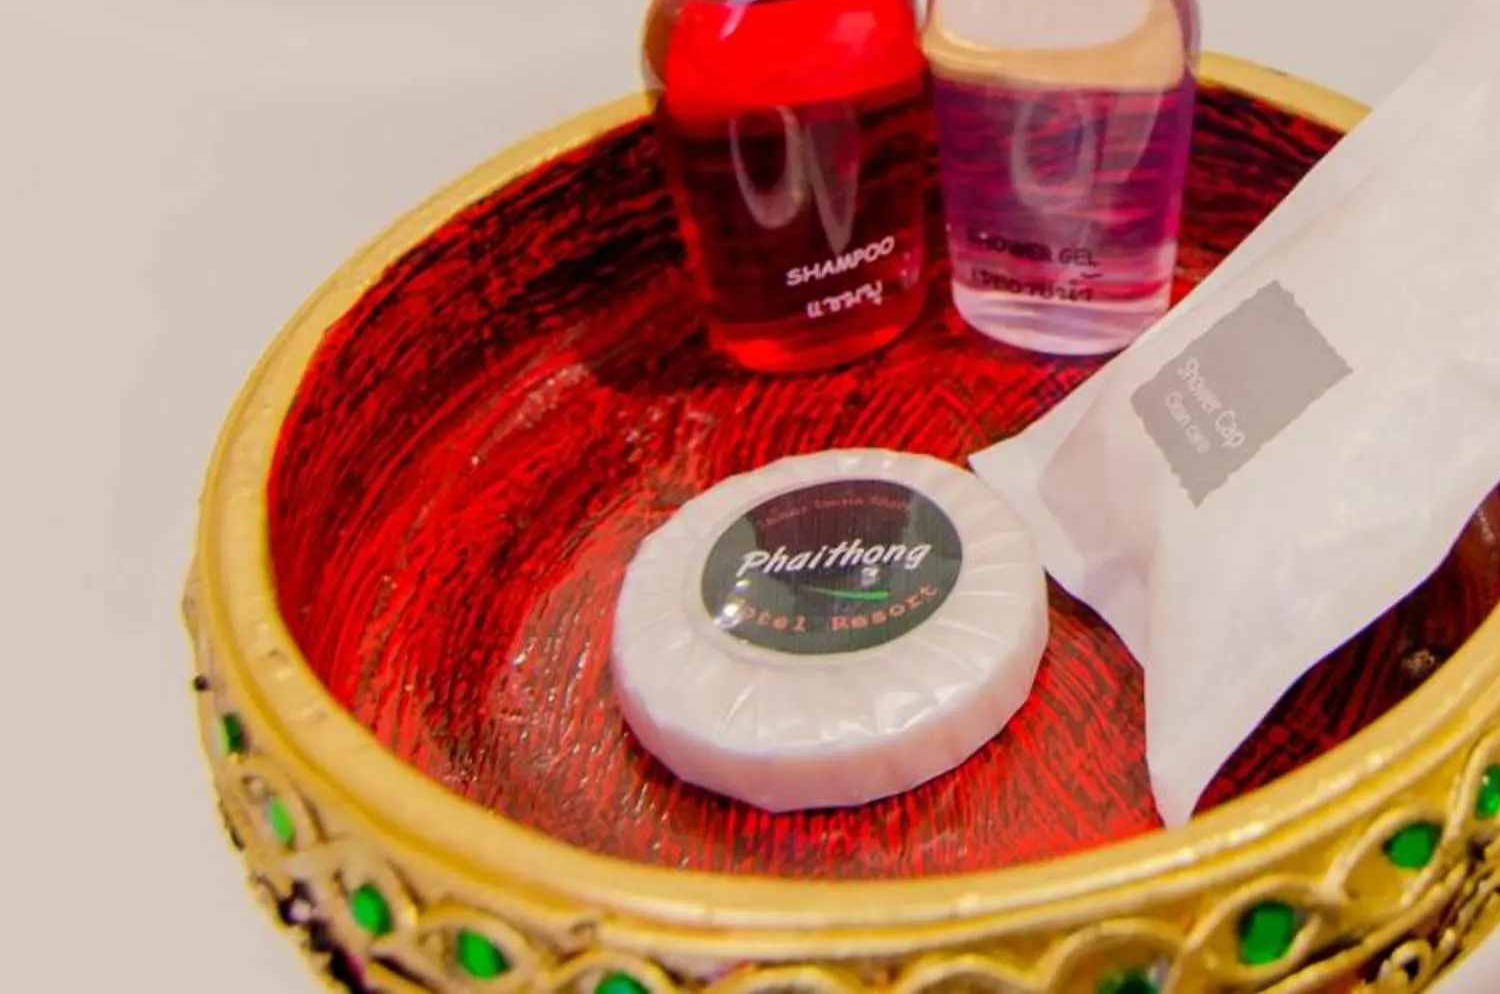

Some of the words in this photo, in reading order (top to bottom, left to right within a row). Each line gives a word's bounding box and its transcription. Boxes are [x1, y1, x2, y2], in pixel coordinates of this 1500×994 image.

[786, 235, 895, 286] SHAMPOO
[1058, 246, 1099, 267] GEL
[1177, 357, 1222, 413] Shower
[1215, 410, 1246, 447] Cap
[736, 539, 933, 578] Phaithong
[728, 598, 809, 633] otel
[831, 582, 938, 631] Resort
